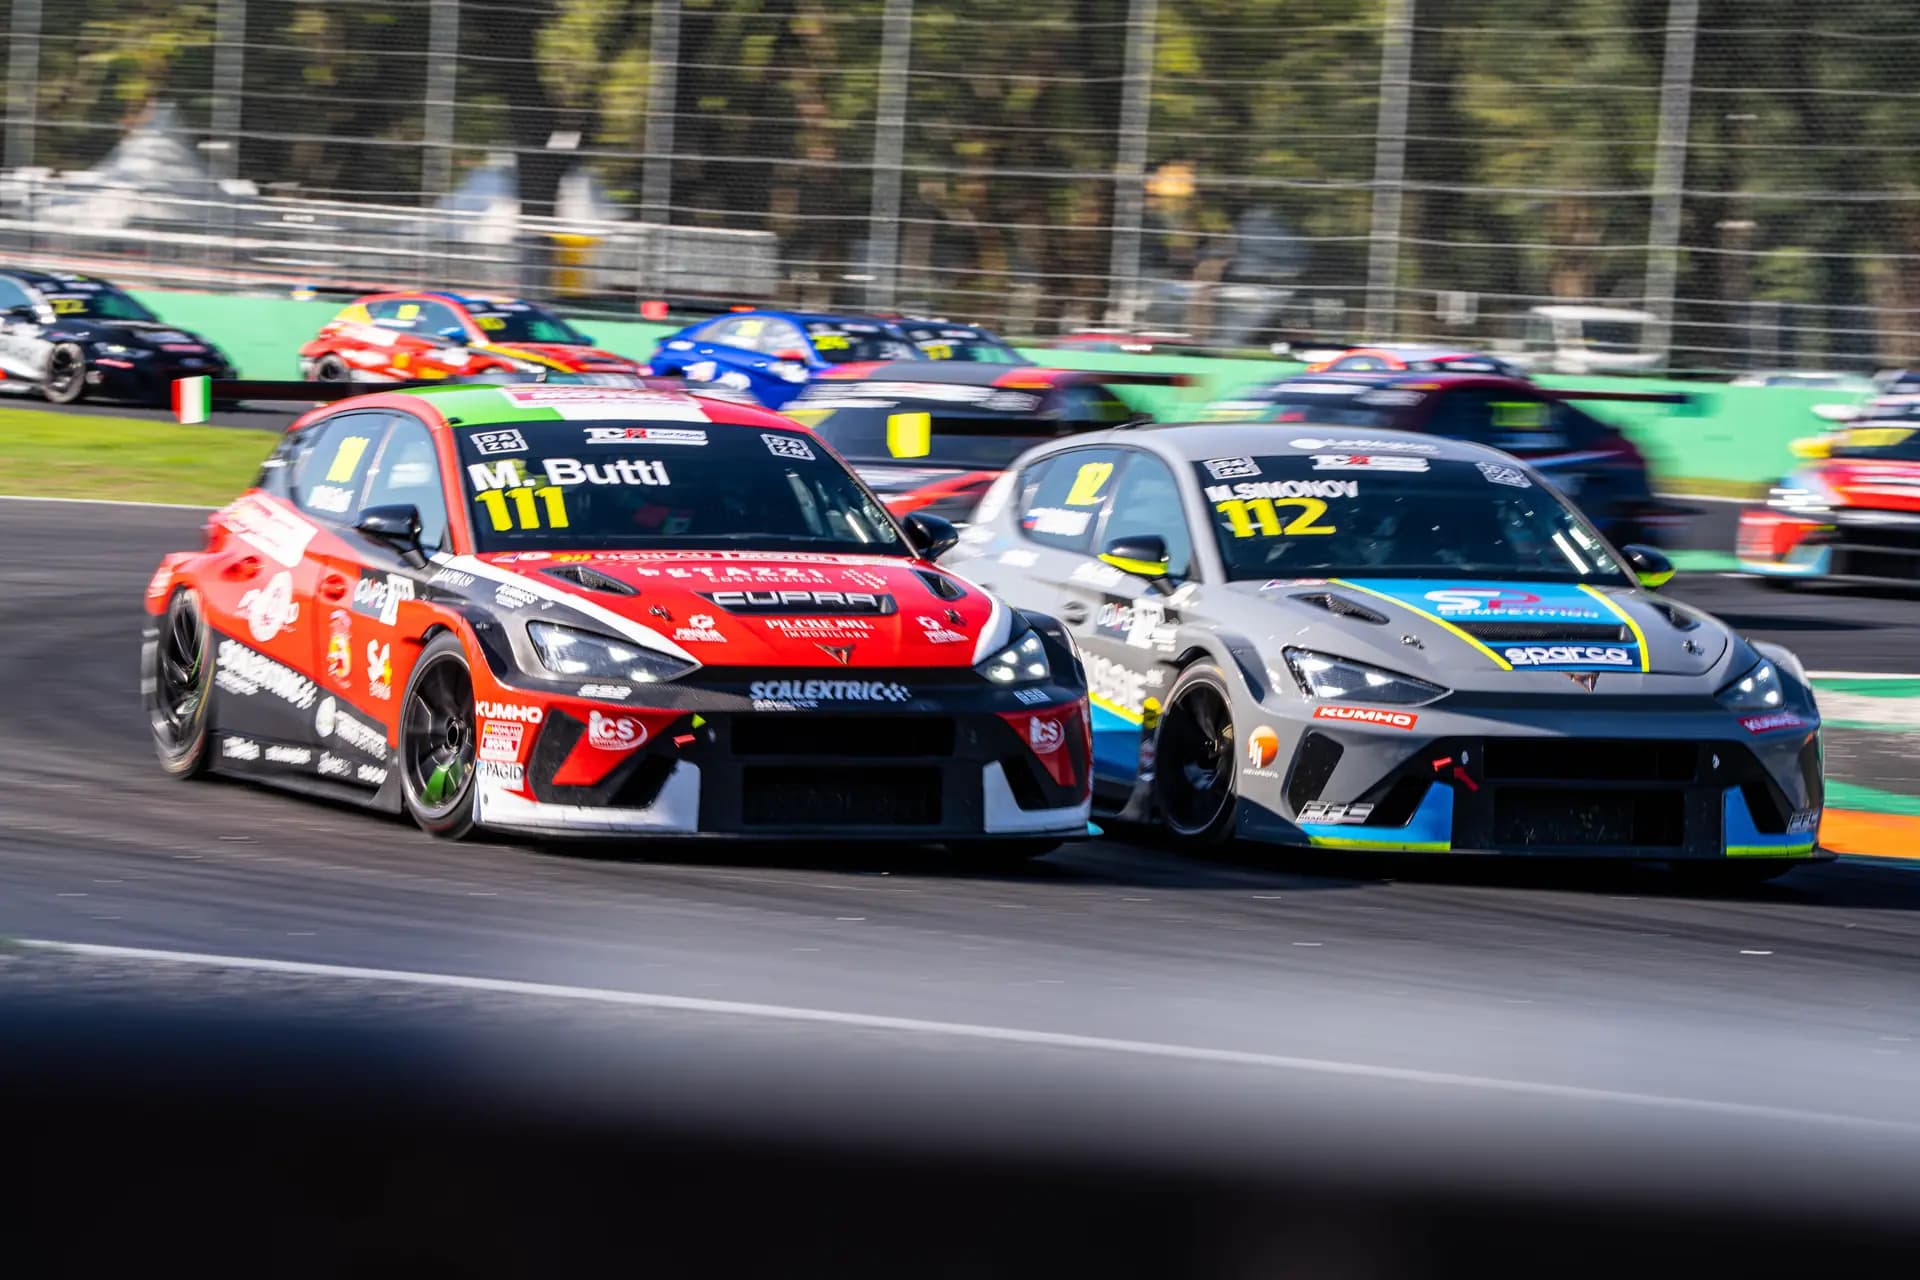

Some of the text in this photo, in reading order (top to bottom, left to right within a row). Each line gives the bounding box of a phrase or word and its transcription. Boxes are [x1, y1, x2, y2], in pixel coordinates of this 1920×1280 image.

[465, 457, 670, 492] M. Butti
[474, 485, 569, 531] 111
[1216, 497, 1337, 538] 112
[712, 590, 878, 609] CUPRA
[1504, 646, 1632, 665] sparco
[750, 680, 886, 702] SCALEXTRIC
[475, 700, 544, 724] KUMHO
[1319, 707, 1412, 727] KUMHO
[486, 760, 524, 781] PAGID
